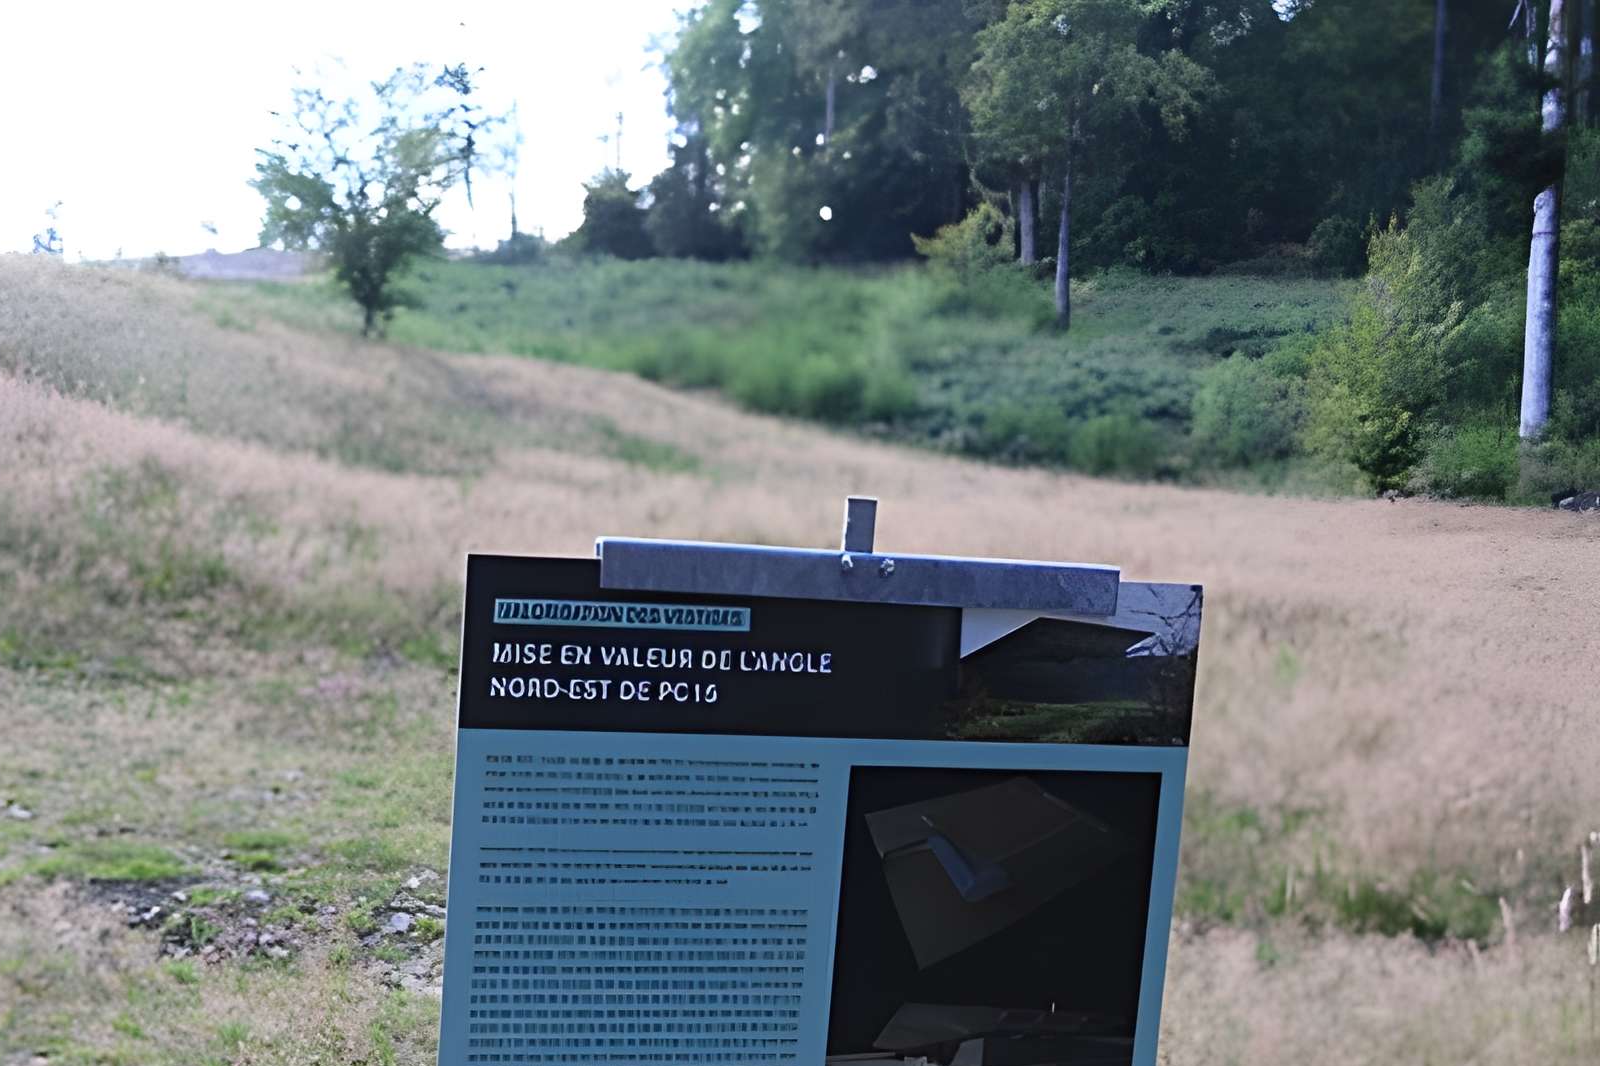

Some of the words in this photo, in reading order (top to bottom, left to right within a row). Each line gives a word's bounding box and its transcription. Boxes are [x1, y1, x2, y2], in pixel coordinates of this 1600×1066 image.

[492, 642, 553, 665] MISE
[560, 644, 592, 665] EN
[600, 646, 693, 669] VALEUR
[619, 679, 652, 702] DE
